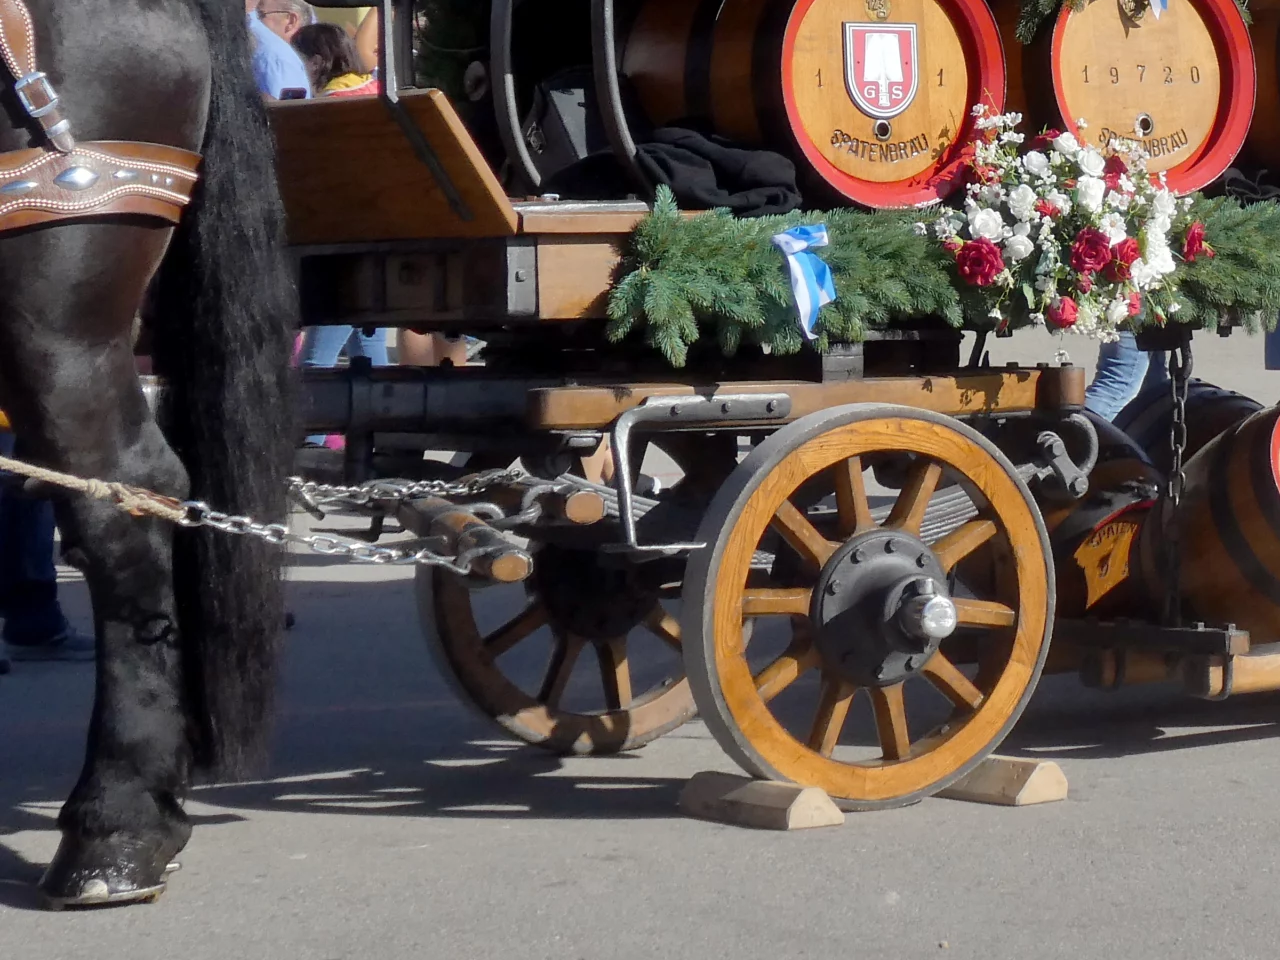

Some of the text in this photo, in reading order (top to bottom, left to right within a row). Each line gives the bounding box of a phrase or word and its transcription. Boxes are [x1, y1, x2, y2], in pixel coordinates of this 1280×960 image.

[815, 67, 945, 88] 1 1
[863, 85, 903, 99] G S
[830, 128, 929, 164] SPATENBRÄU
